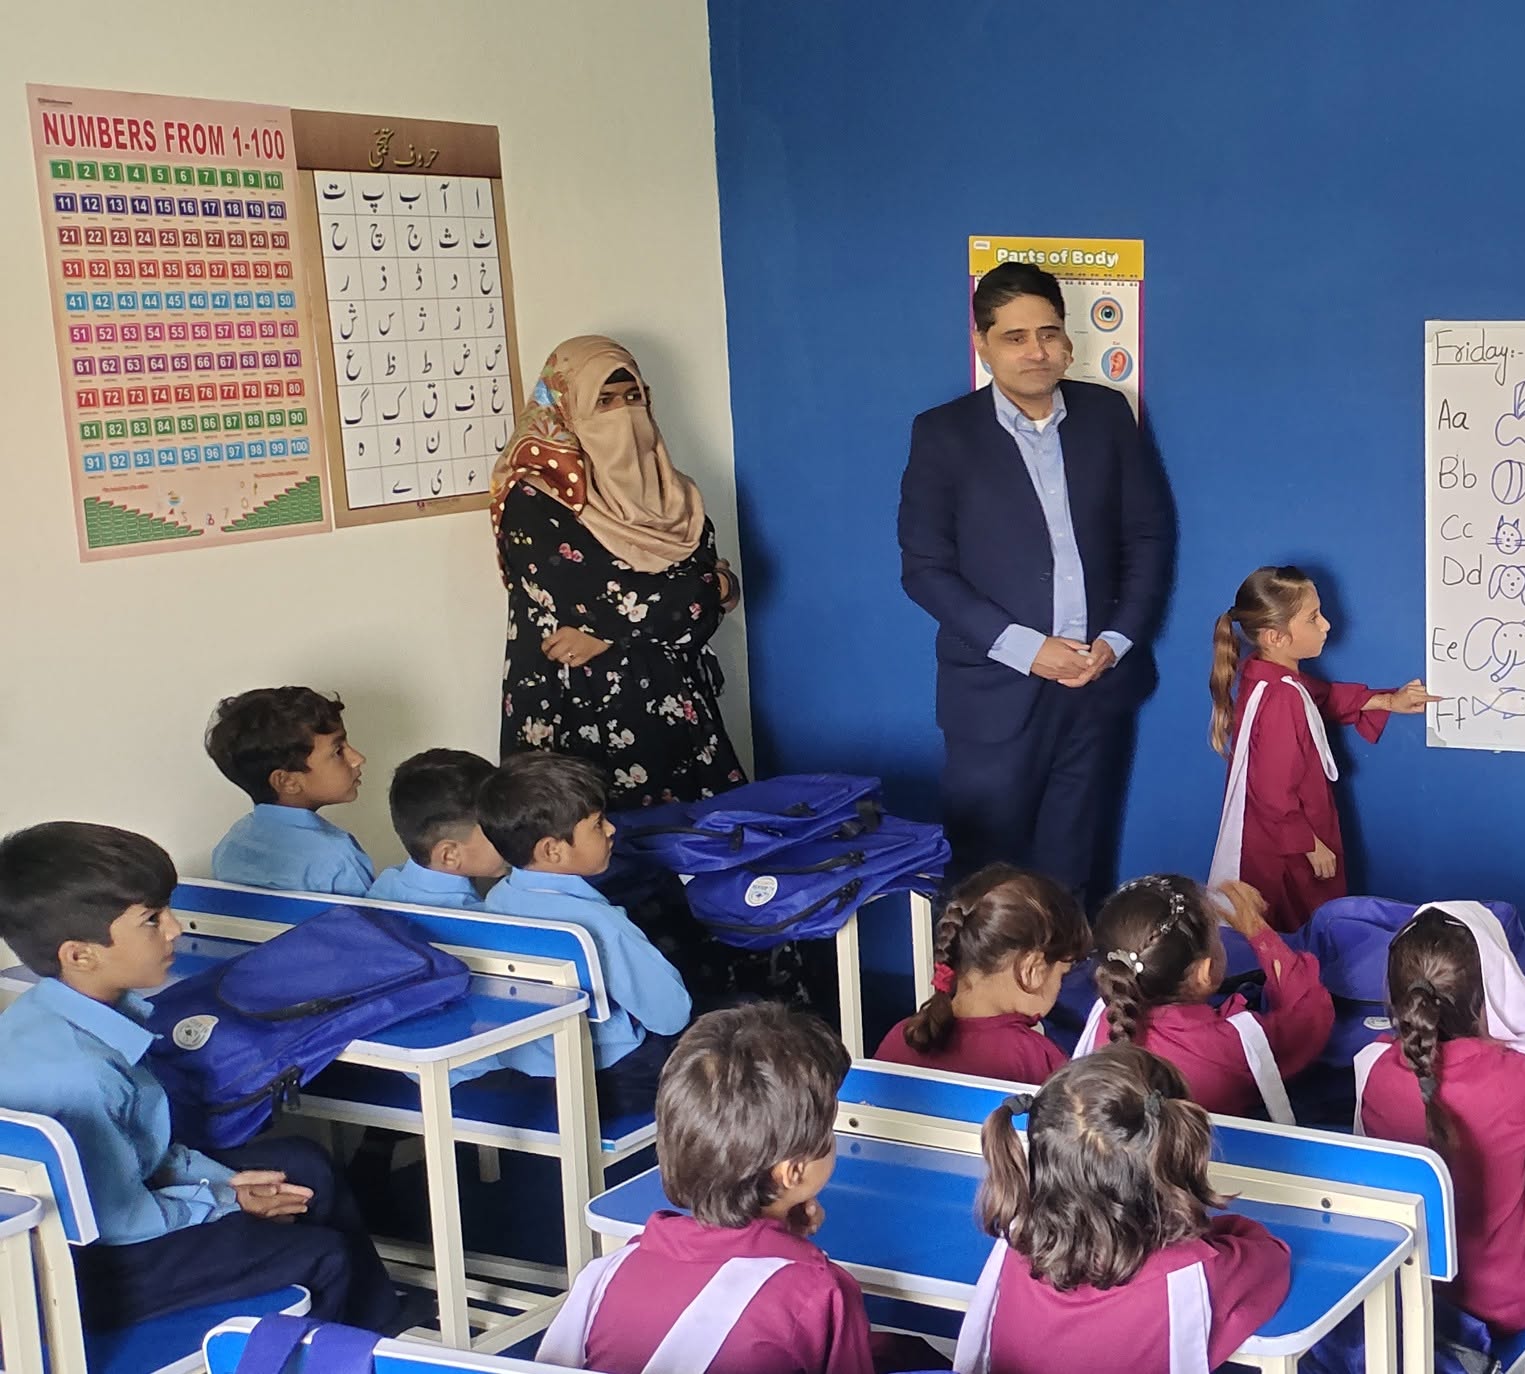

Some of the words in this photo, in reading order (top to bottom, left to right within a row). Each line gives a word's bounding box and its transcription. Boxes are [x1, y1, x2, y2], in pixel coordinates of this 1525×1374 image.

[43, 112, 156, 152] NUMBERS
[164, 122, 225, 156] FROM
[232, 126, 285, 160] 1-100
[393, 143, 440, 168] حروف
[57, 164, 64, 176] 1
[83, 165, 91, 177] 2
[108, 166, 115, 178] 3
[132, 168, 140, 179] 4
[157, 169, 164, 181] 5
[180, 170, 187, 182] 6
[203, 171, 209, 182] 7
[226, 173, 232, 184] 8
[248, 174, 254, 185] 9
[267, 175, 279, 186] 10
[322, 184, 346, 200] ت
[362, 191, 384, 213] پ
[399, 192, 421, 210] ب
[58, 197, 71, 209] 11
[84, 198, 98, 210] 12
[109, 198, 123, 211] 13
[134, 199, 147, 211] 14
[158, 200, 171, 212] 15
[181, 201, 194, 213] 16
[204, 202, 217, 214] 17
[226, 203, 239, 215] 18
[249, 204, 262, 216] 19
[270, 205, 282, 216] 20
[61, 230, 75, 242] 21
[87, 230, 102, 242] 22
[113, 231, 127, 243] 23
[137, 232, 151, 243] 24
[161, 232, 175, 244] 25
[185, 233, 198, 244] 26
[208, 233, 220, 245] 27
[230, 234, 242, 245] 28
[252, 234, 264, 246] 29
[273, 235, 286, 246] 30
[331, 222, 347, 251] ح
[370, 223, 385, 251] چ
[407, 224, 422, 251] ج
[439, 228, 459, 248] ث
[997, 249, 1045, 263] Parts
[1050, 250, 1068, 263] of
[65, 263, 79, 275] 31
[91, 263, 106, 275] 32
[117, 263, 130, 275] 33
[141, 263, 154, 275] 34
[165, 264, 178, 275] 35
[188, 264, 202, 275] 36
[211, 264, 223, 276] 37
[233, 264, 246, 276] 38
[255, 265, 268, 276] 39
[276, 265, 289, 276] 40
[379, 266, 387, 291] ذ
[451, 273, 458, 290] د
[480, 262, 493, 295] خ
[340, 276, 349, 292] ر
[69, 296, 82, 307] 41
[95, 295, 109, 307] 42
[120, 295, 133, 307] 43
[144, 295, 157, 306] 44
[168, 295, 181, 306] 45
[214, 295, 226, 306] 47
[340, 303, 358, 340] ش
[378, 312, 395, 336] س
[418, 307, 427, 332] ژ
[454, 306, 461, 330] ز
[73, 328, 86, 340] 51
[99, 327, 112, 340] 52
[123, 327, 137, 339] 53
[147, 327, 160, 338] 54
[171, 326, 184, 338] 55
[194, 326, 207, 337] 56
[217, 325, 230, 337] 57
[239, 325, 252, 336] 58
[76, 360, 90, 373] 61
[102, 359, 116, 372] 62
[126, 359, 140, 371] 63
[150, 358, 163, 370] 64
[174, 357, 187, 369] 65
[197, 356, 210, 368] 66
[219, 356, 232, 367] 67
[242, 355, 255, 366] 68
[264, 354, 276, 365] 69
[346, 349, 361, 381] ع
[385, 352, 396, 376] ظ
[422, 351, 432, 374] ط
[453, 343, 470, 376] ض
[485, 344, 502, 371] ص
[79, 393, 93, 405] 71
[105, 391, 119, 403] 72
[129, 390, 143, 402] 73
[153, 389, 167, 400] 74
[177, 388, 190, 399] 75
[199, 387, 213, 398] 76
[222, 386, 234, 397] 77
[244, 385, 257, 396] 78
[266, 384, 279, 395] 79
[344, 387, 370, 425] گ
[422, 382, 438, 419] ق
[454, 385, 475, 411] ف
[491, 378, 504, 414] غ
[83, 425, 96, 437] 81
[108, 423, 123, 435] 82
[133, 422, 147, 434] 83
[157, 420, 170, 432] 84
[180, 419, 194, 430] 85
[203, 417, 216, 429] 86
[225, 416, 237, 428] 87
[247, 414, 260, 426] 88
[1438, 399, 1469, 430] Aa
[394, 437, 401, 454] و
[426, 431, 440, 454] ن
[463, 423, 472, 455] م
[495, 419, 508, 452] ل
[86, 456, 100, 469] 91
[112, 455, 125, 467] 92
[136, 453, 150, 465] 93
[160, 451, 174, 463] 94
[183, 449, 196, 461] 95
[206, 447, 219, 459] 96
[228, 446, 240, 457] 97
[290, 441, 308, 452] 100
[1439, 456, 1477, 489] Bb
[392, 481, 412, 494] ے
[1441, 514, 1473, 540] Cc
[1442, 554, 1482, 585] Dd
[1432, 627, 1458, 662] Ee
[1436, 697, 1468, 732] Ff
